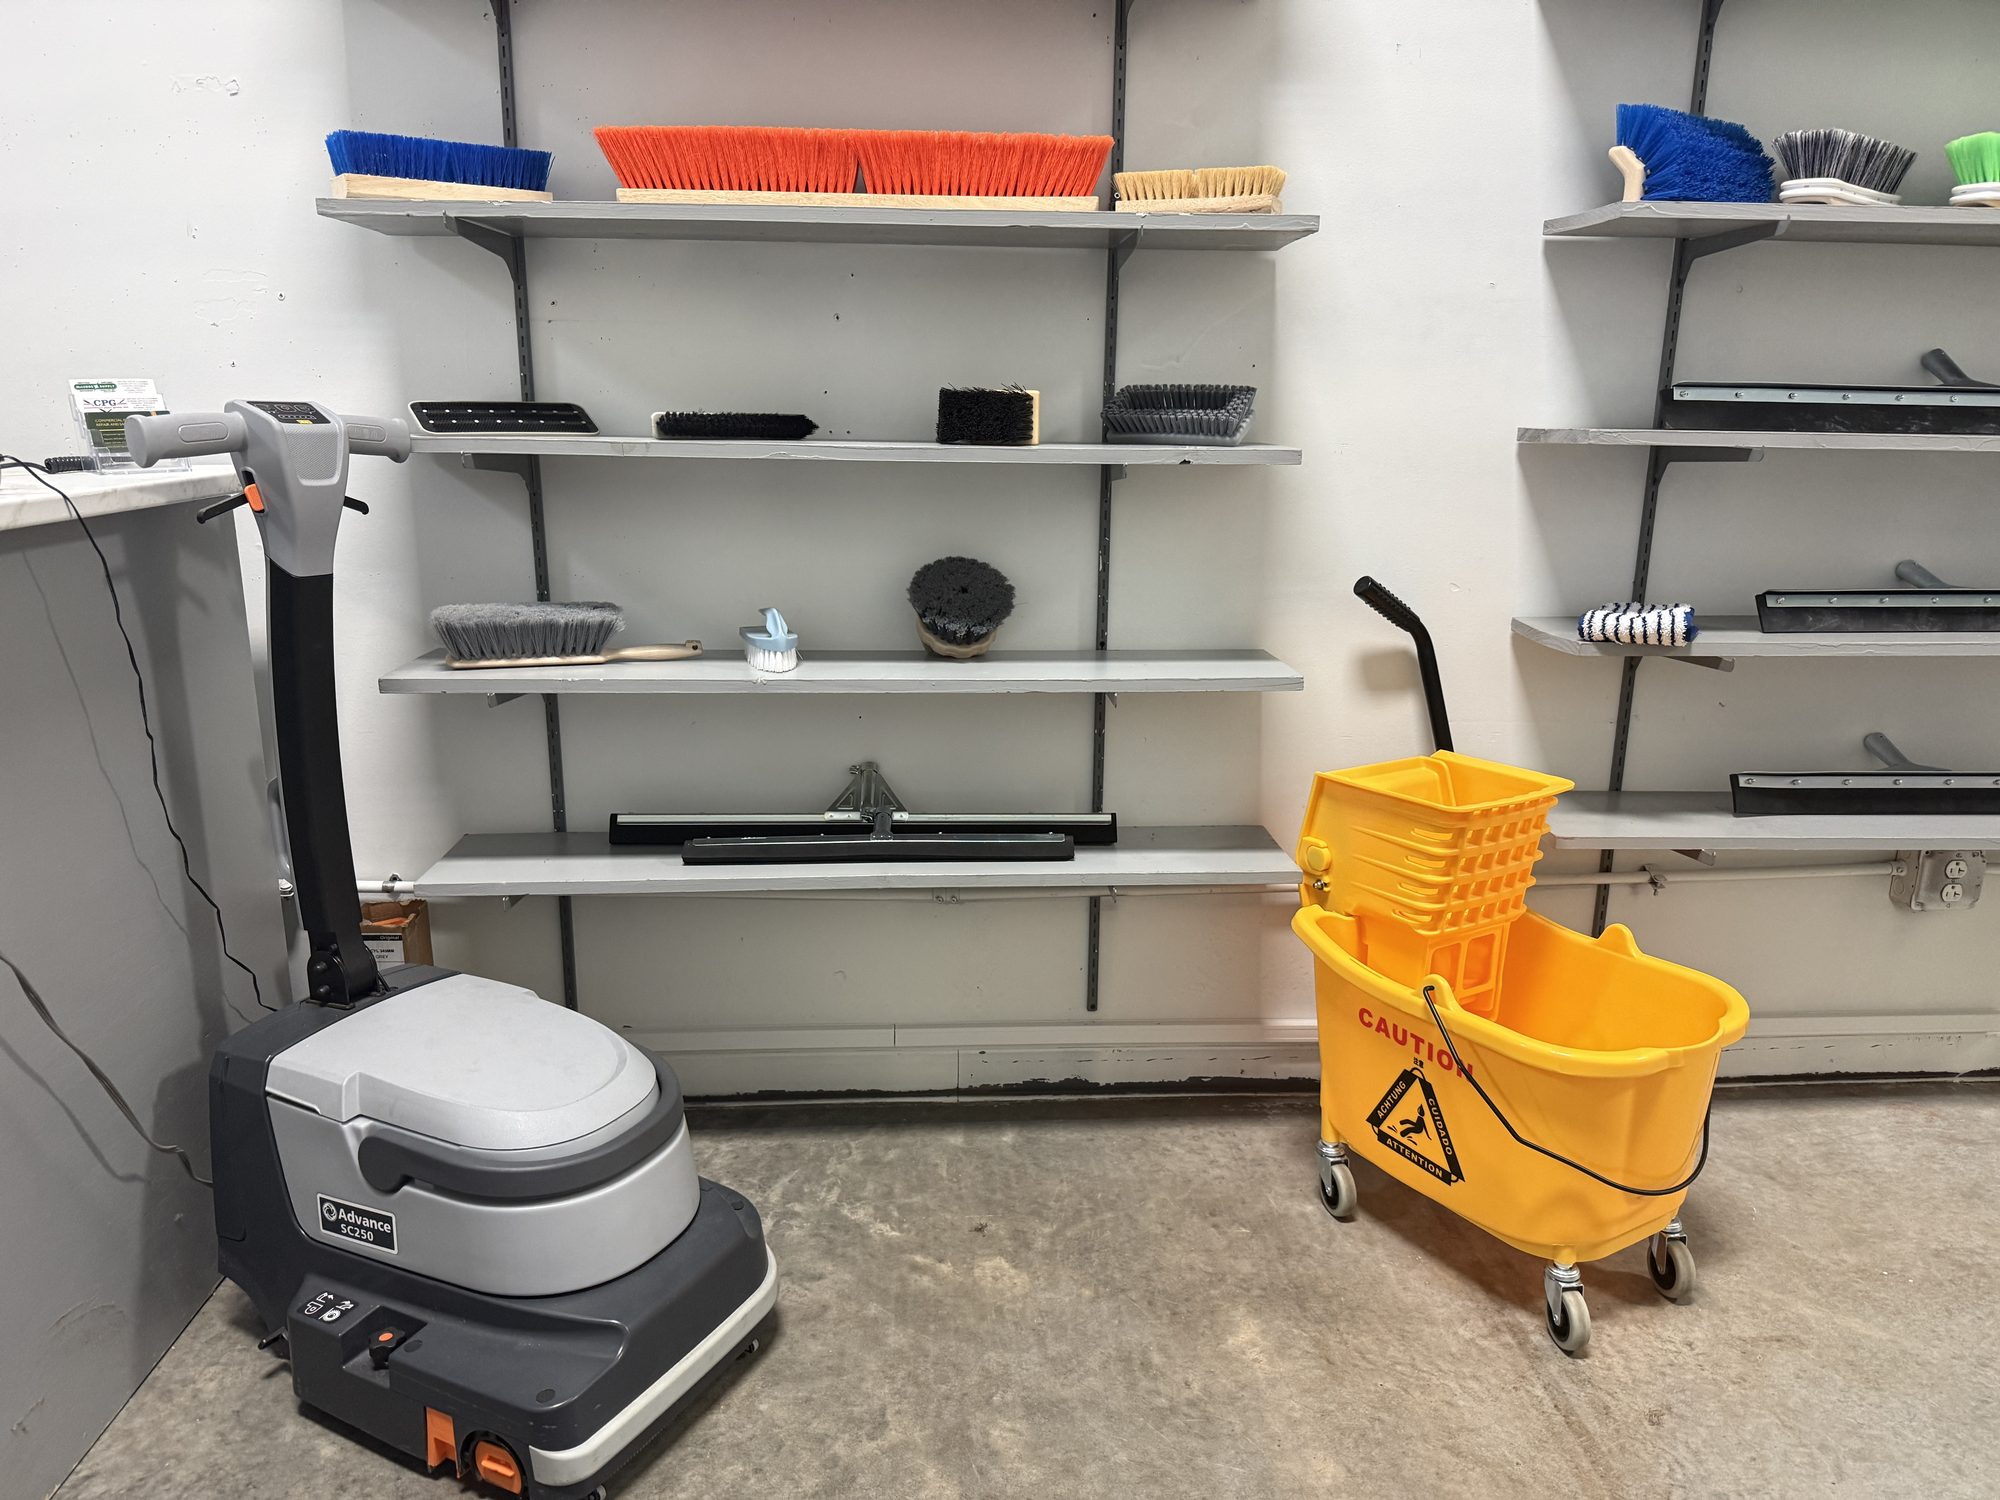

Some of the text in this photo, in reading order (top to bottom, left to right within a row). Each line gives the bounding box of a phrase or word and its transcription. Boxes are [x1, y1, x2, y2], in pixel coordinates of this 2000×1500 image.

[93, 399, 117, 407] CPG
[1377, 1080, 1407, 1119] ACHTUNG
[1427, 1097, 1453, 1156] CUIDADO
[1386, 1137, 1444, 1179] ATTENTION
[338, 1208, 392, 1233] Advance
[340, 1224, 374, 1242] SC250
